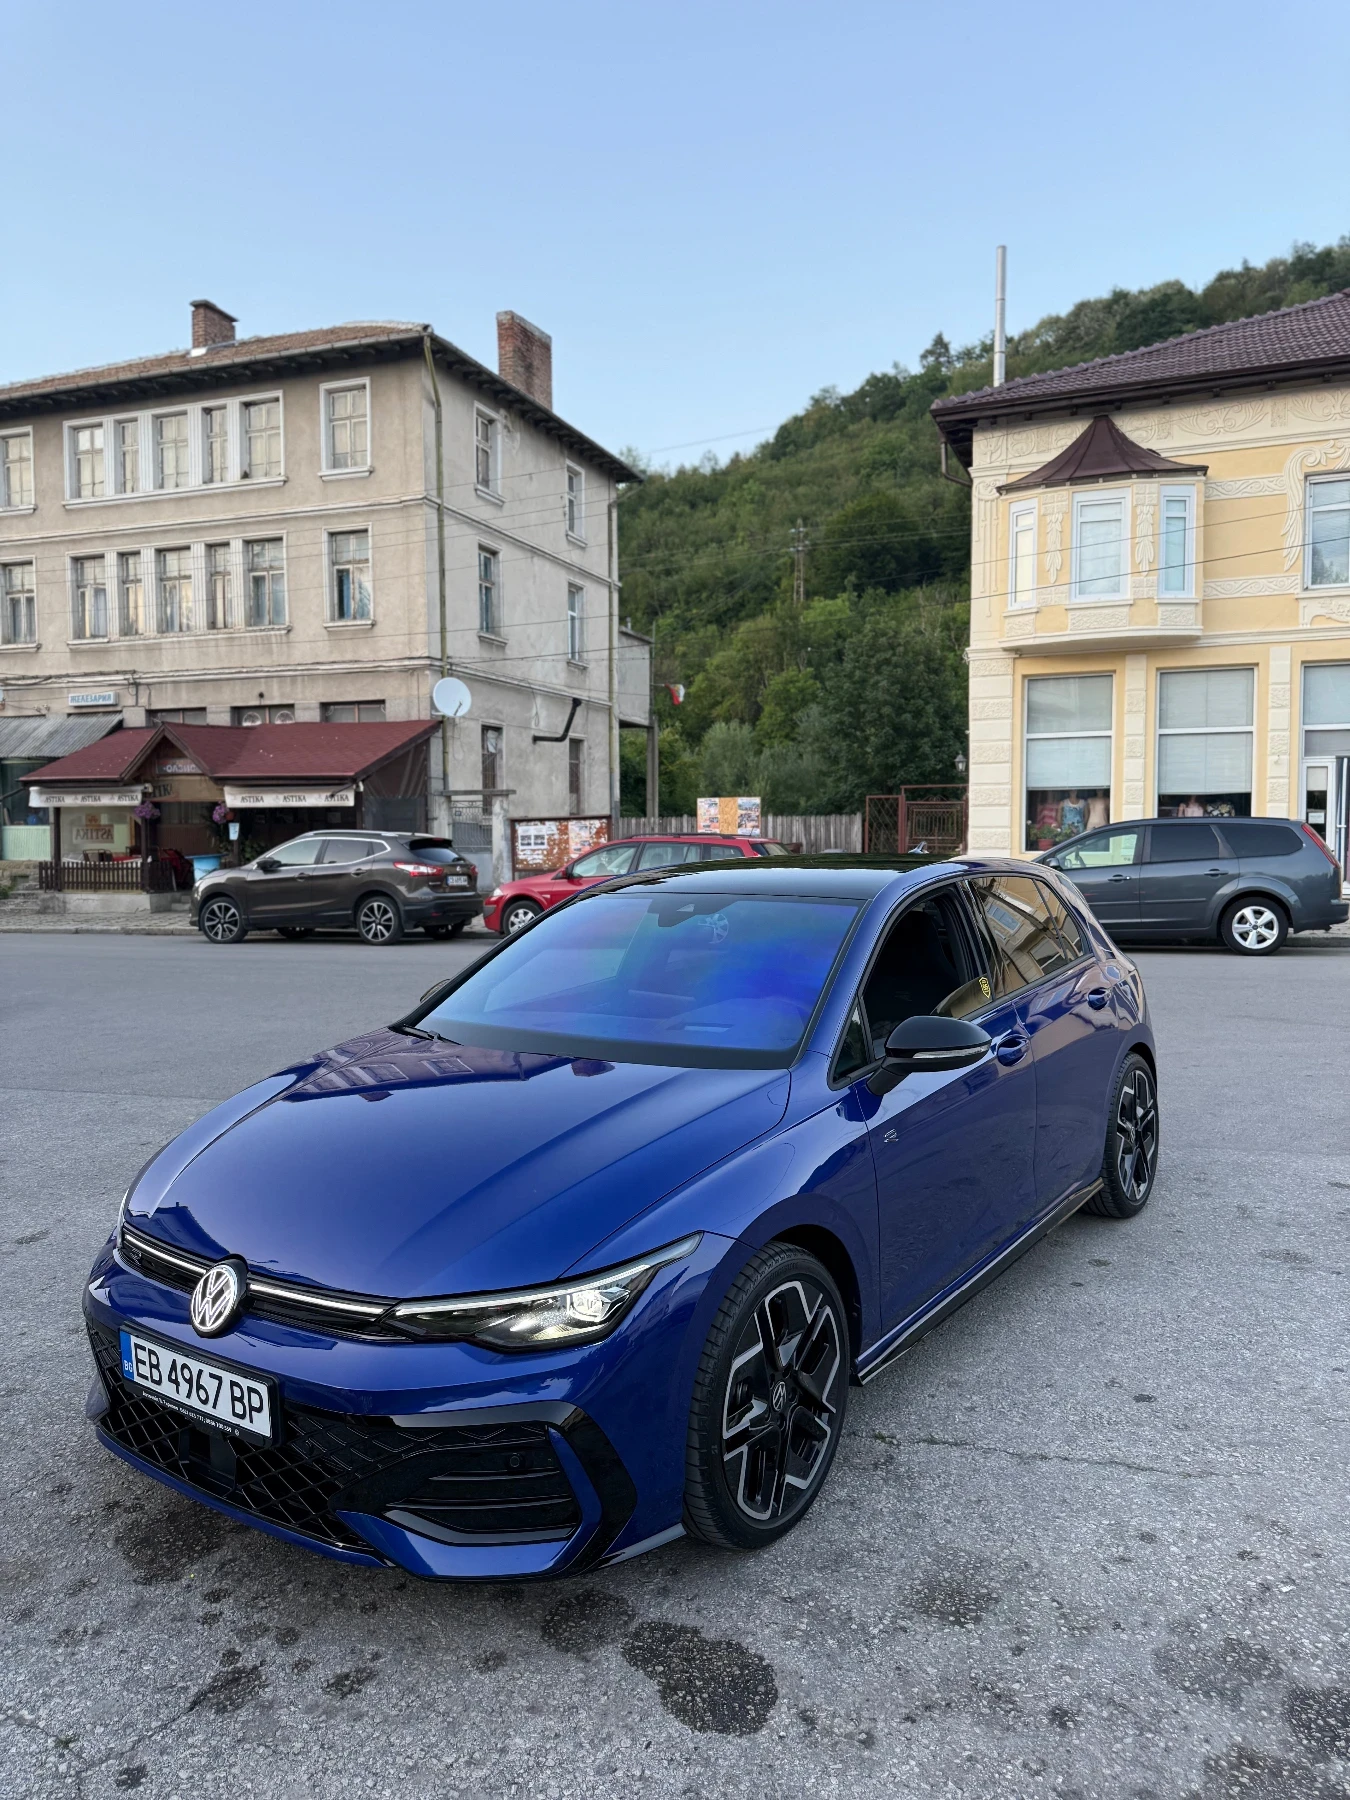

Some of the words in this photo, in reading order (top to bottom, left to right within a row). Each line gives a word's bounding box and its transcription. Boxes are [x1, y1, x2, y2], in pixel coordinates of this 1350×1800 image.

[70, 694, 111, 703] ЖЕЛЕЗАРИЯ
[283, 795, 307, 803] ASTIKA
[123, 1359, 133, 1373] BG
[134, 1342, 163, 1386] EB
[168, 1358, 223, 1410] 4967
[230, 1379, 264, 1424] BP
